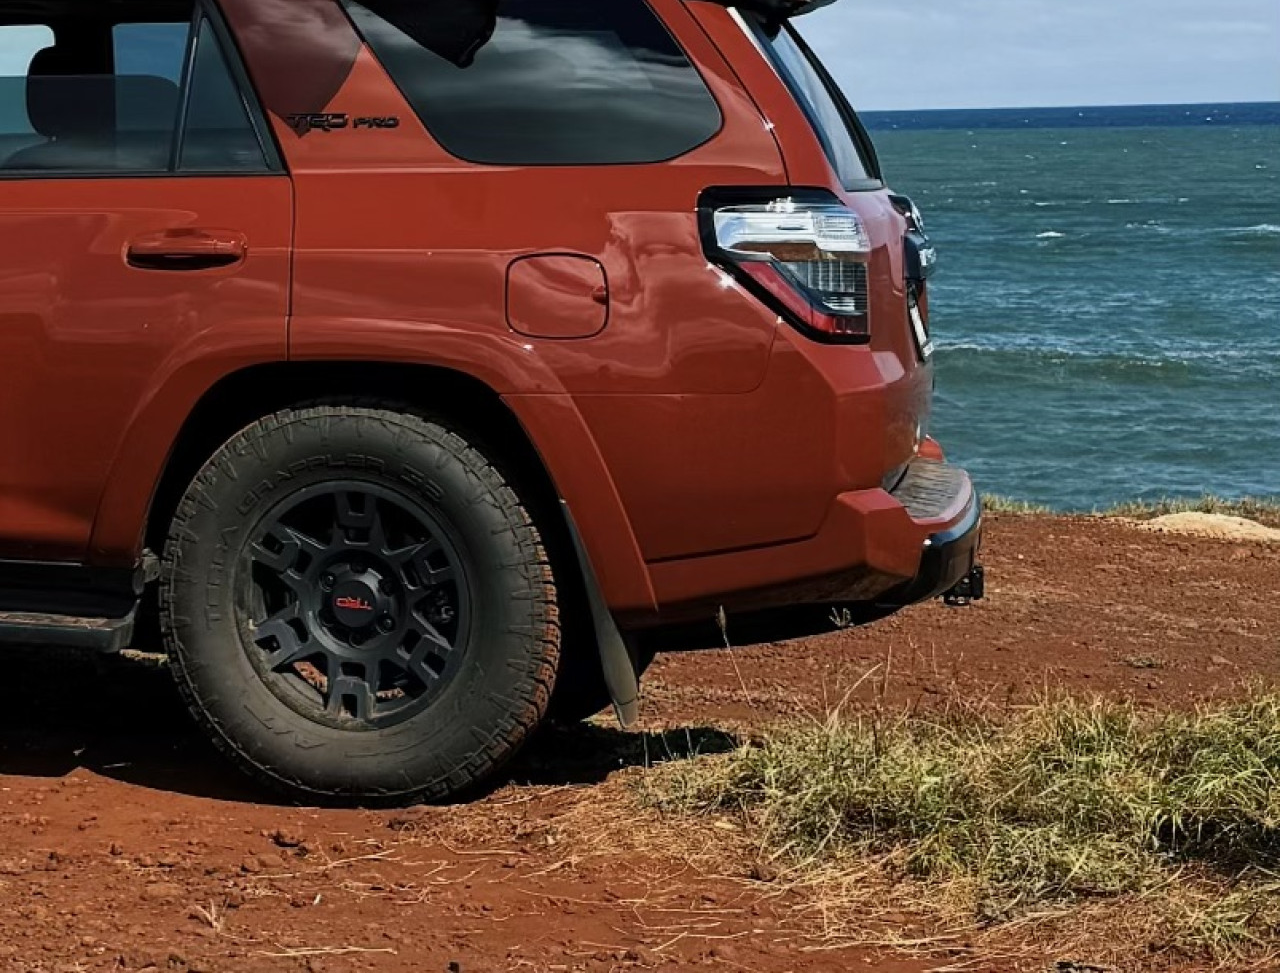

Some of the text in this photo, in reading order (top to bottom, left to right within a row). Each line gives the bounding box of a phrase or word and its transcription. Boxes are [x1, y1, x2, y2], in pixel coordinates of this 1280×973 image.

[286, 113, 399, 132] TRD PRO
[236, 453, 385, 516] GRAPPLER
